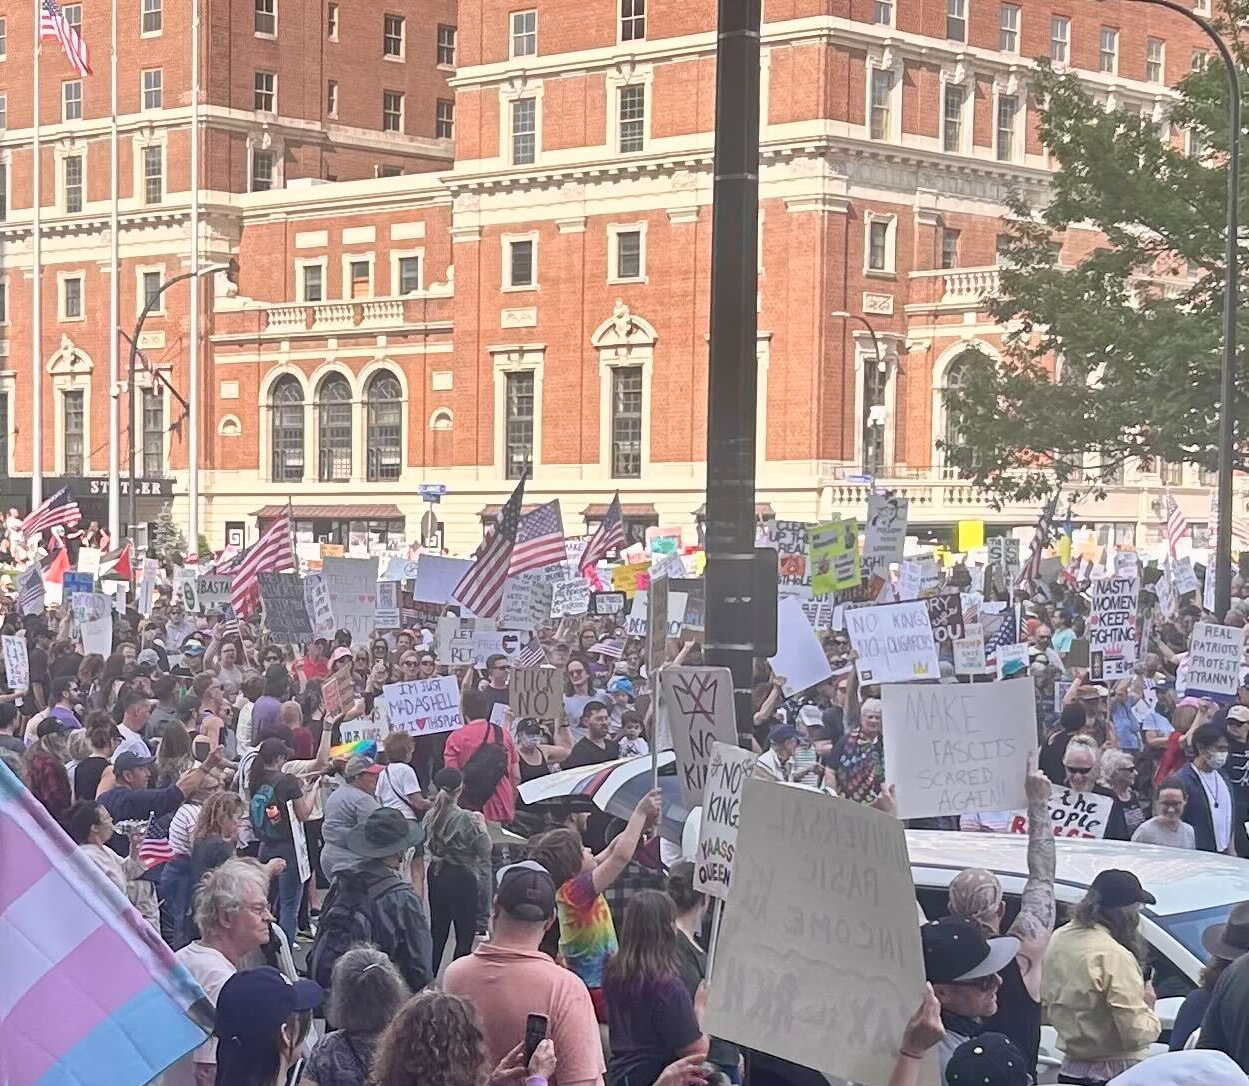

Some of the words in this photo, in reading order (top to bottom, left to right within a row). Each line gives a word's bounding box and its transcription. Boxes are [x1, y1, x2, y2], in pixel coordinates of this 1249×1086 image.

[91, 480, 161, 495] STTER
[1096, 578, 1136, 594] NASTY
[1092, 595, 1137, 611] WOMEN
[852, 614, 878, 634] NO
[1099, 611, 1130, 627] KEEP
[1090, 627, 1135, 645] FIGHTING
[1204, 626, 1233, 640] REAL
[1193, 641, 1239, 657] PATRIOTS
[1192, 655, 1239, 673] PROTEST
[422, 680, 441, 693] JUST
[514, 668, 555, 694] FUCK
[1188, 671, 1236, 689] TYRANNY
[518, 690, 550, 716] NO
[905, 692, 983, 735] MAKE
[689, 730, 717, 761] NO
[932, 737, 1017, 765] FASCITS
[719, 762, 743, 795] NO
[918, 767, 993, 790] SCARED
[1060, 789, 1098, 814] the
[701, 837, 735, 862] YAASS
[699, 863, 731, 888] QUEEN
